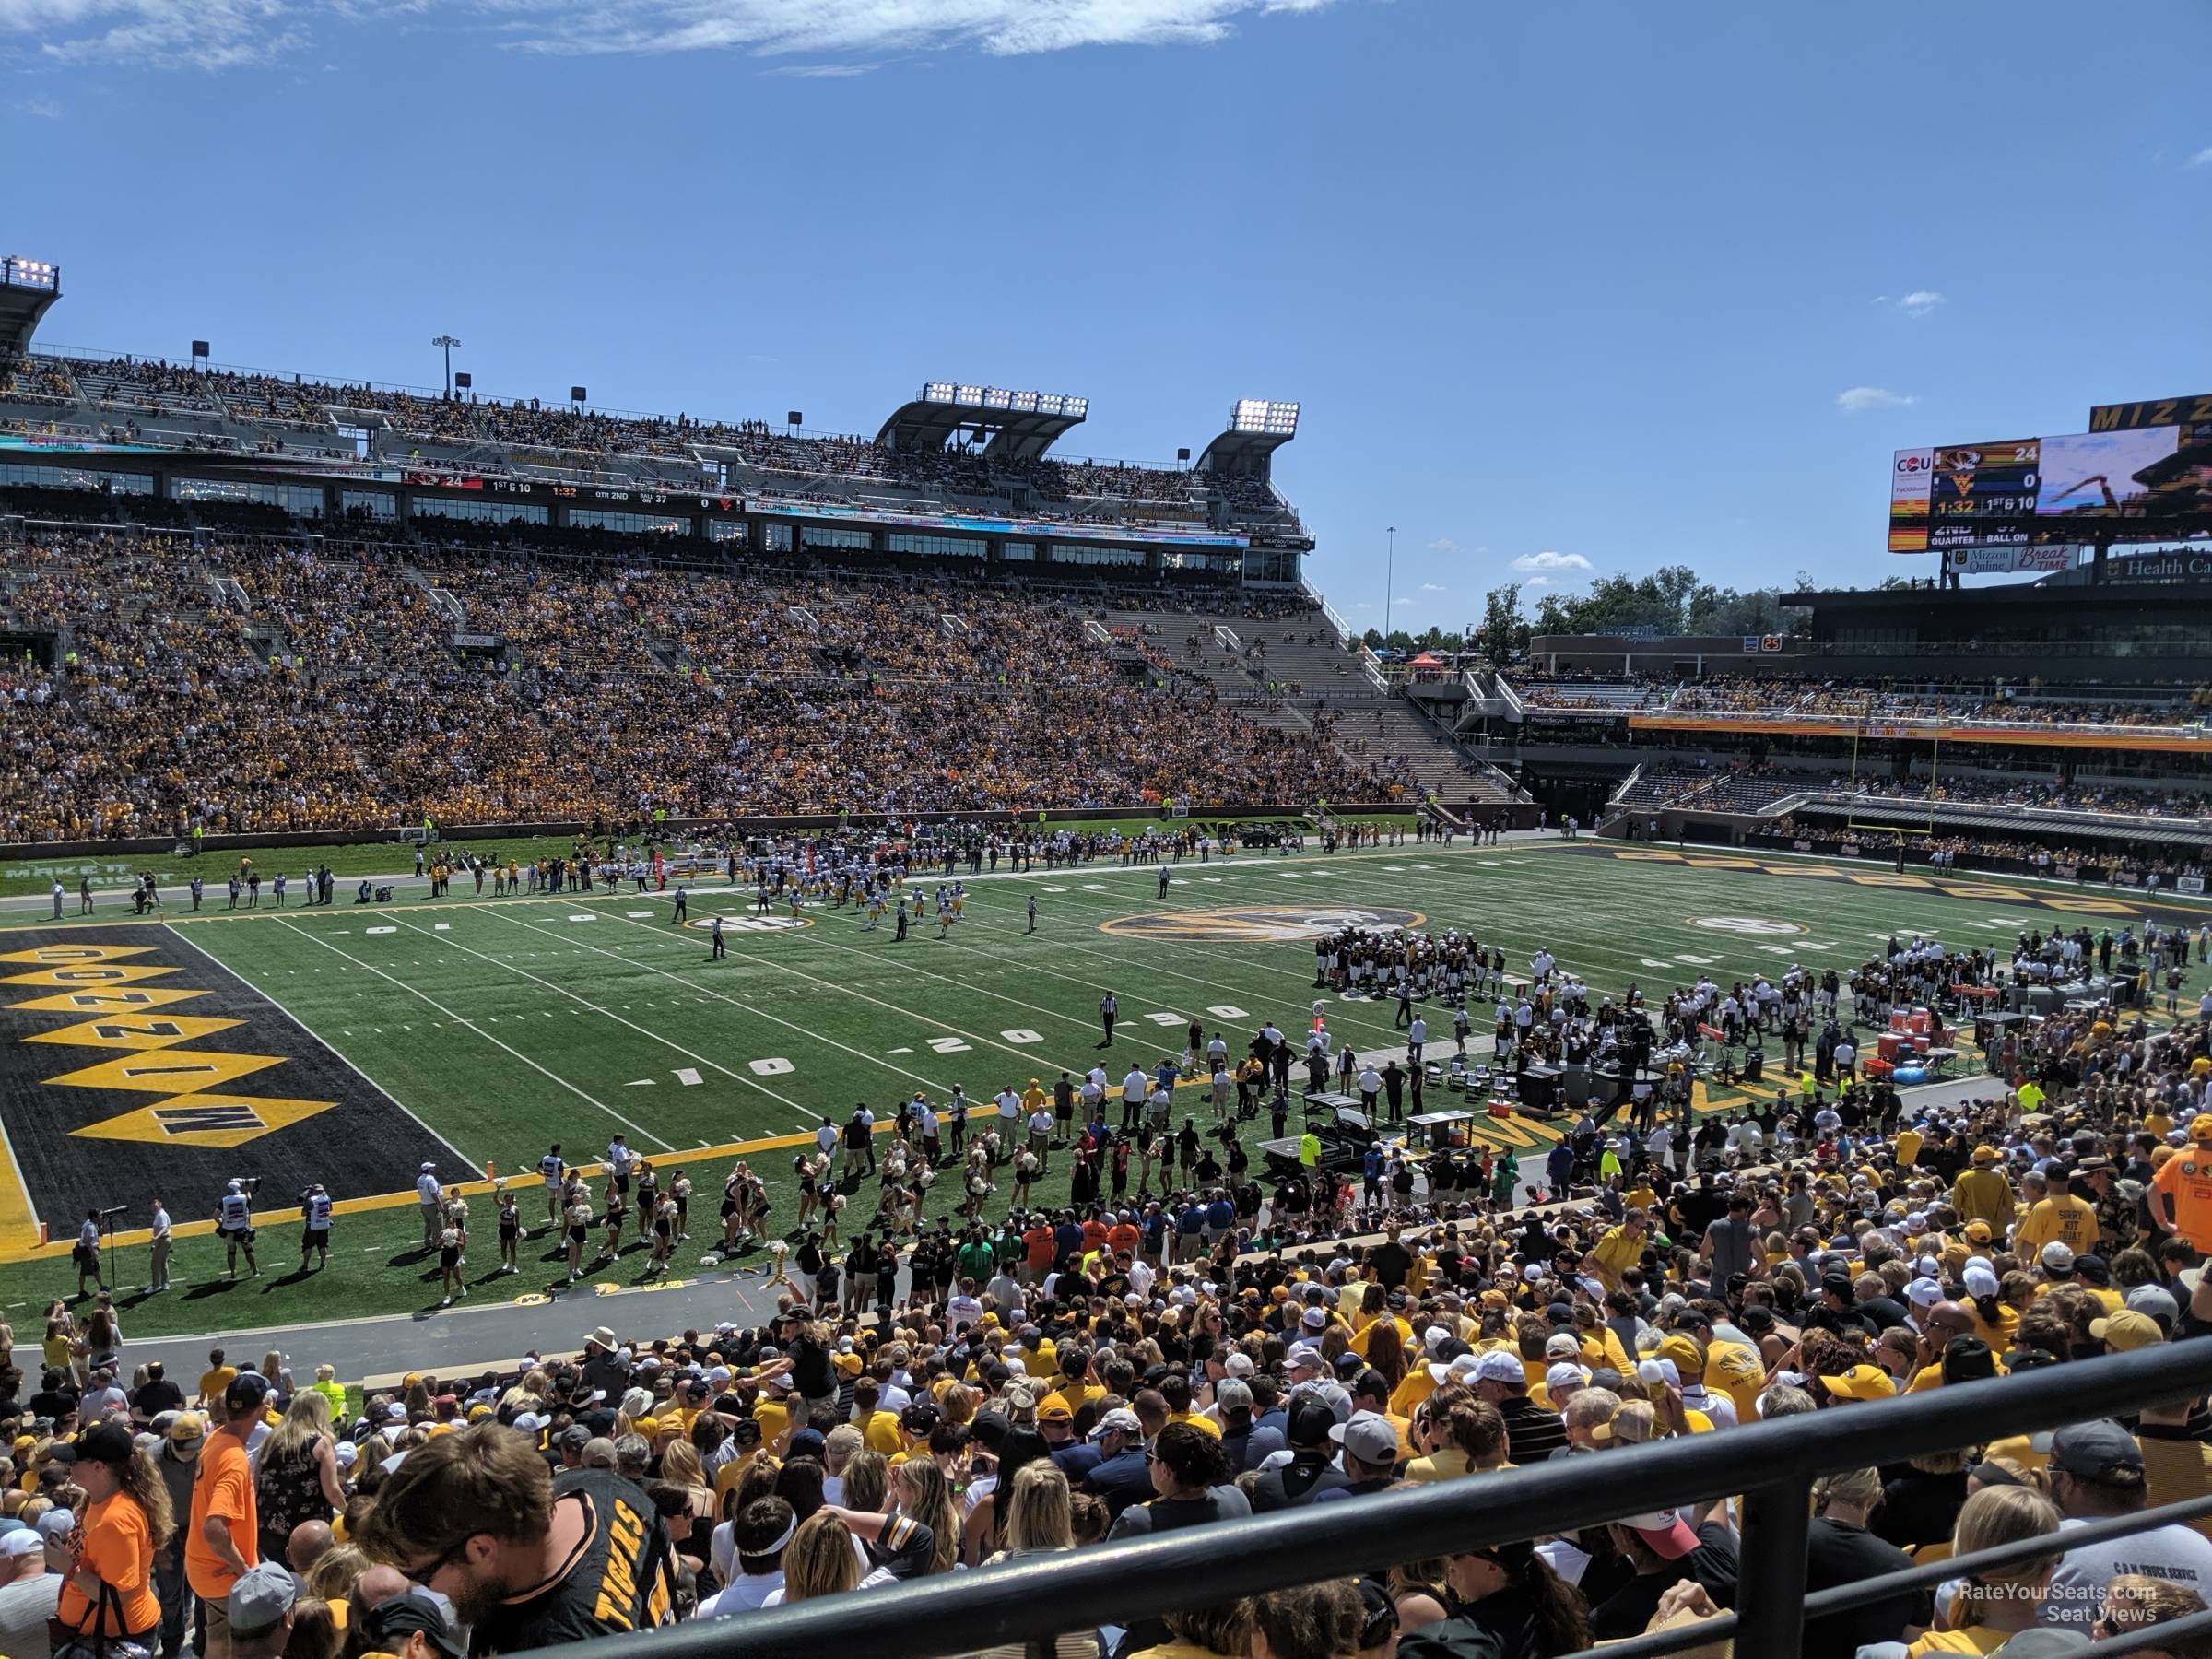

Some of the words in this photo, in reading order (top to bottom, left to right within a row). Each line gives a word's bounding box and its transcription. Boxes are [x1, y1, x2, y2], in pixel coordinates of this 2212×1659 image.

[2014, 447, 2038, 462] 24
[446, 477, 462, 487] 24
[2023, 474, 2036, 488] 0
[493, 481, 507, 491] 1ST
[519, 483, 531, 493] 10
[553, 486, 577, 496] 1:32
[611, 492, 629, 500] 2ND
[655, 495, 667, 503] 37
[700, 499, 709, 508] 0
[1938, 500, 1974, 514] 1:32
[1987, 498, 2004, 511] 1ST
[2018, 496, 2035, 510] 10
[1931, 535, 1975, 546] QUARTER
[1986, 534, 2011, 543] BALL
[2013, 533, 2029, 542] ON
[1971, 550, 2009, 560] Mizzou
[2019, 545, 2073, 568] Break
[1969, 561, 2005, 571] Online
[2038, 560, 2068, 570] TIME
[2127, 559, 2183, 576] Health
[1623, 635, 1665, 644] Corporation
[1765, 639, 1779, 649] 25
[1869, 725, 1896, 736] Health
[1899, 727, 1918, 737] Care
[5, 865, 99, 878] MAKE
[105, 864, 133, 873] IT
[88, 874, 176, 885] RIGT
[1143, 1005, 1251, 1032] 30
[36, 950, 268, 1136] MIZZOU
[925, 1029, 1045, 1054] 20
[670, 1057, 796, 1087] 10
[2064, 1220, 2079, 1230] NOT
[2057, 1230, 2083, 1241] TODAY
[2113, 1562, 2121, 1575] C
[2139, 1564, 2169, 1579] TRUCK
[2167, 1567, 2198, 1581] SERVICE
